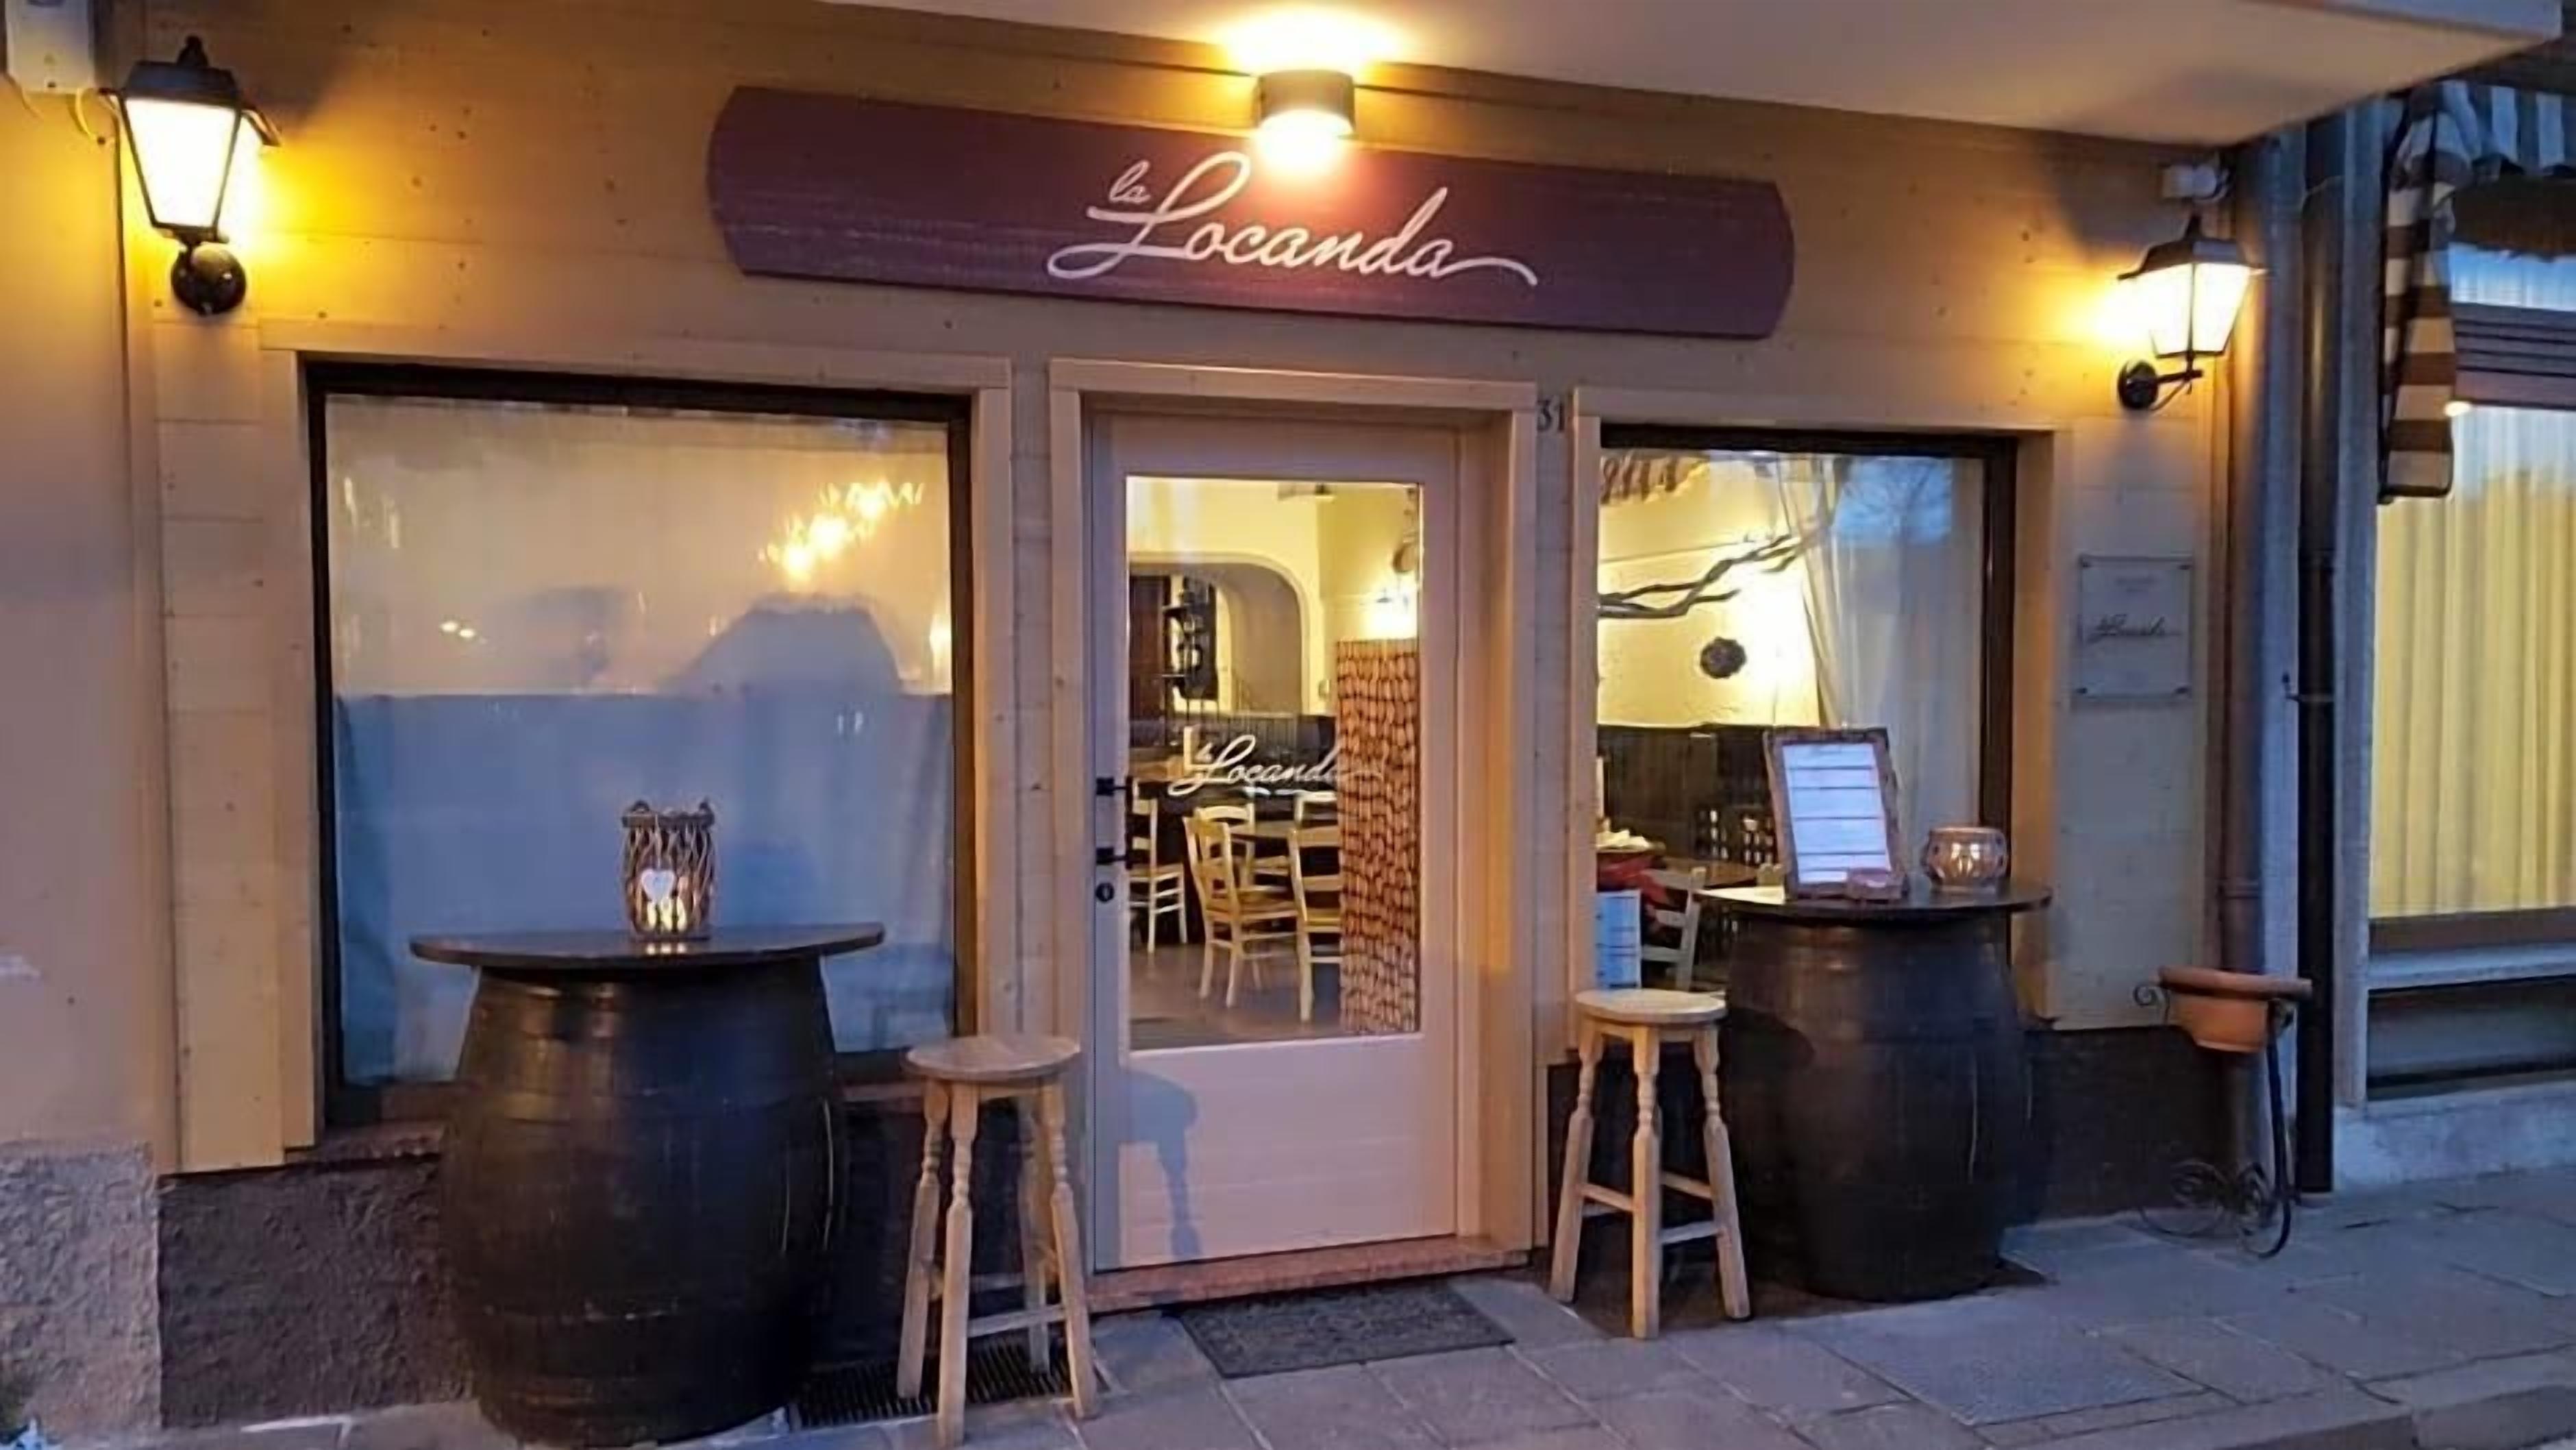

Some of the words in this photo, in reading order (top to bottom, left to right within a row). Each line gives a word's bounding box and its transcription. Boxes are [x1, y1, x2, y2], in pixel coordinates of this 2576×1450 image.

[1109, 159, 1152, 204] la
[1046, 150, 1539, 288] Locanda
[1536, 399, 1565, 433] 31
